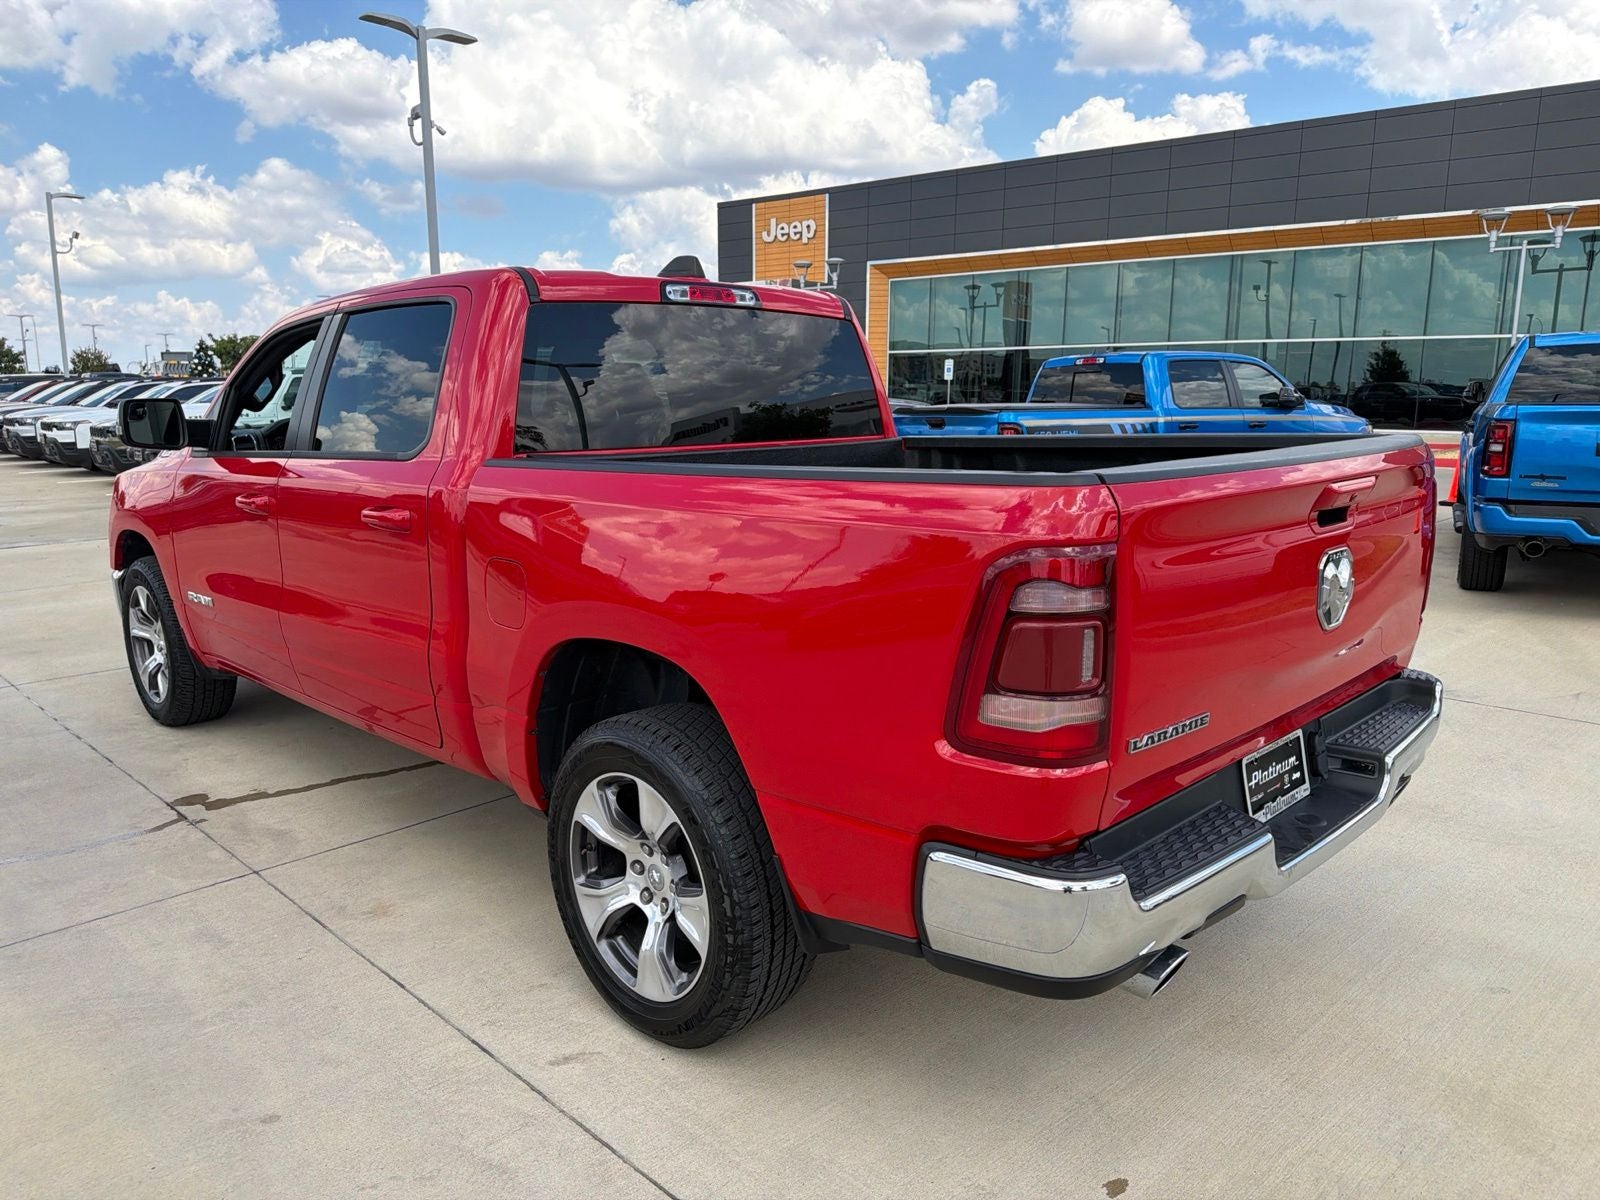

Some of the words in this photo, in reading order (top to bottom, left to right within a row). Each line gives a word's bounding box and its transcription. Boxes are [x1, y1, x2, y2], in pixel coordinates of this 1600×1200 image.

[762, 217, 816, 244] Jeep
[187, 591, 215, 608] RAM
[1131, 713, 1210, 753] LARAMIE
[1248, 754, 1300, 789] Platinum
